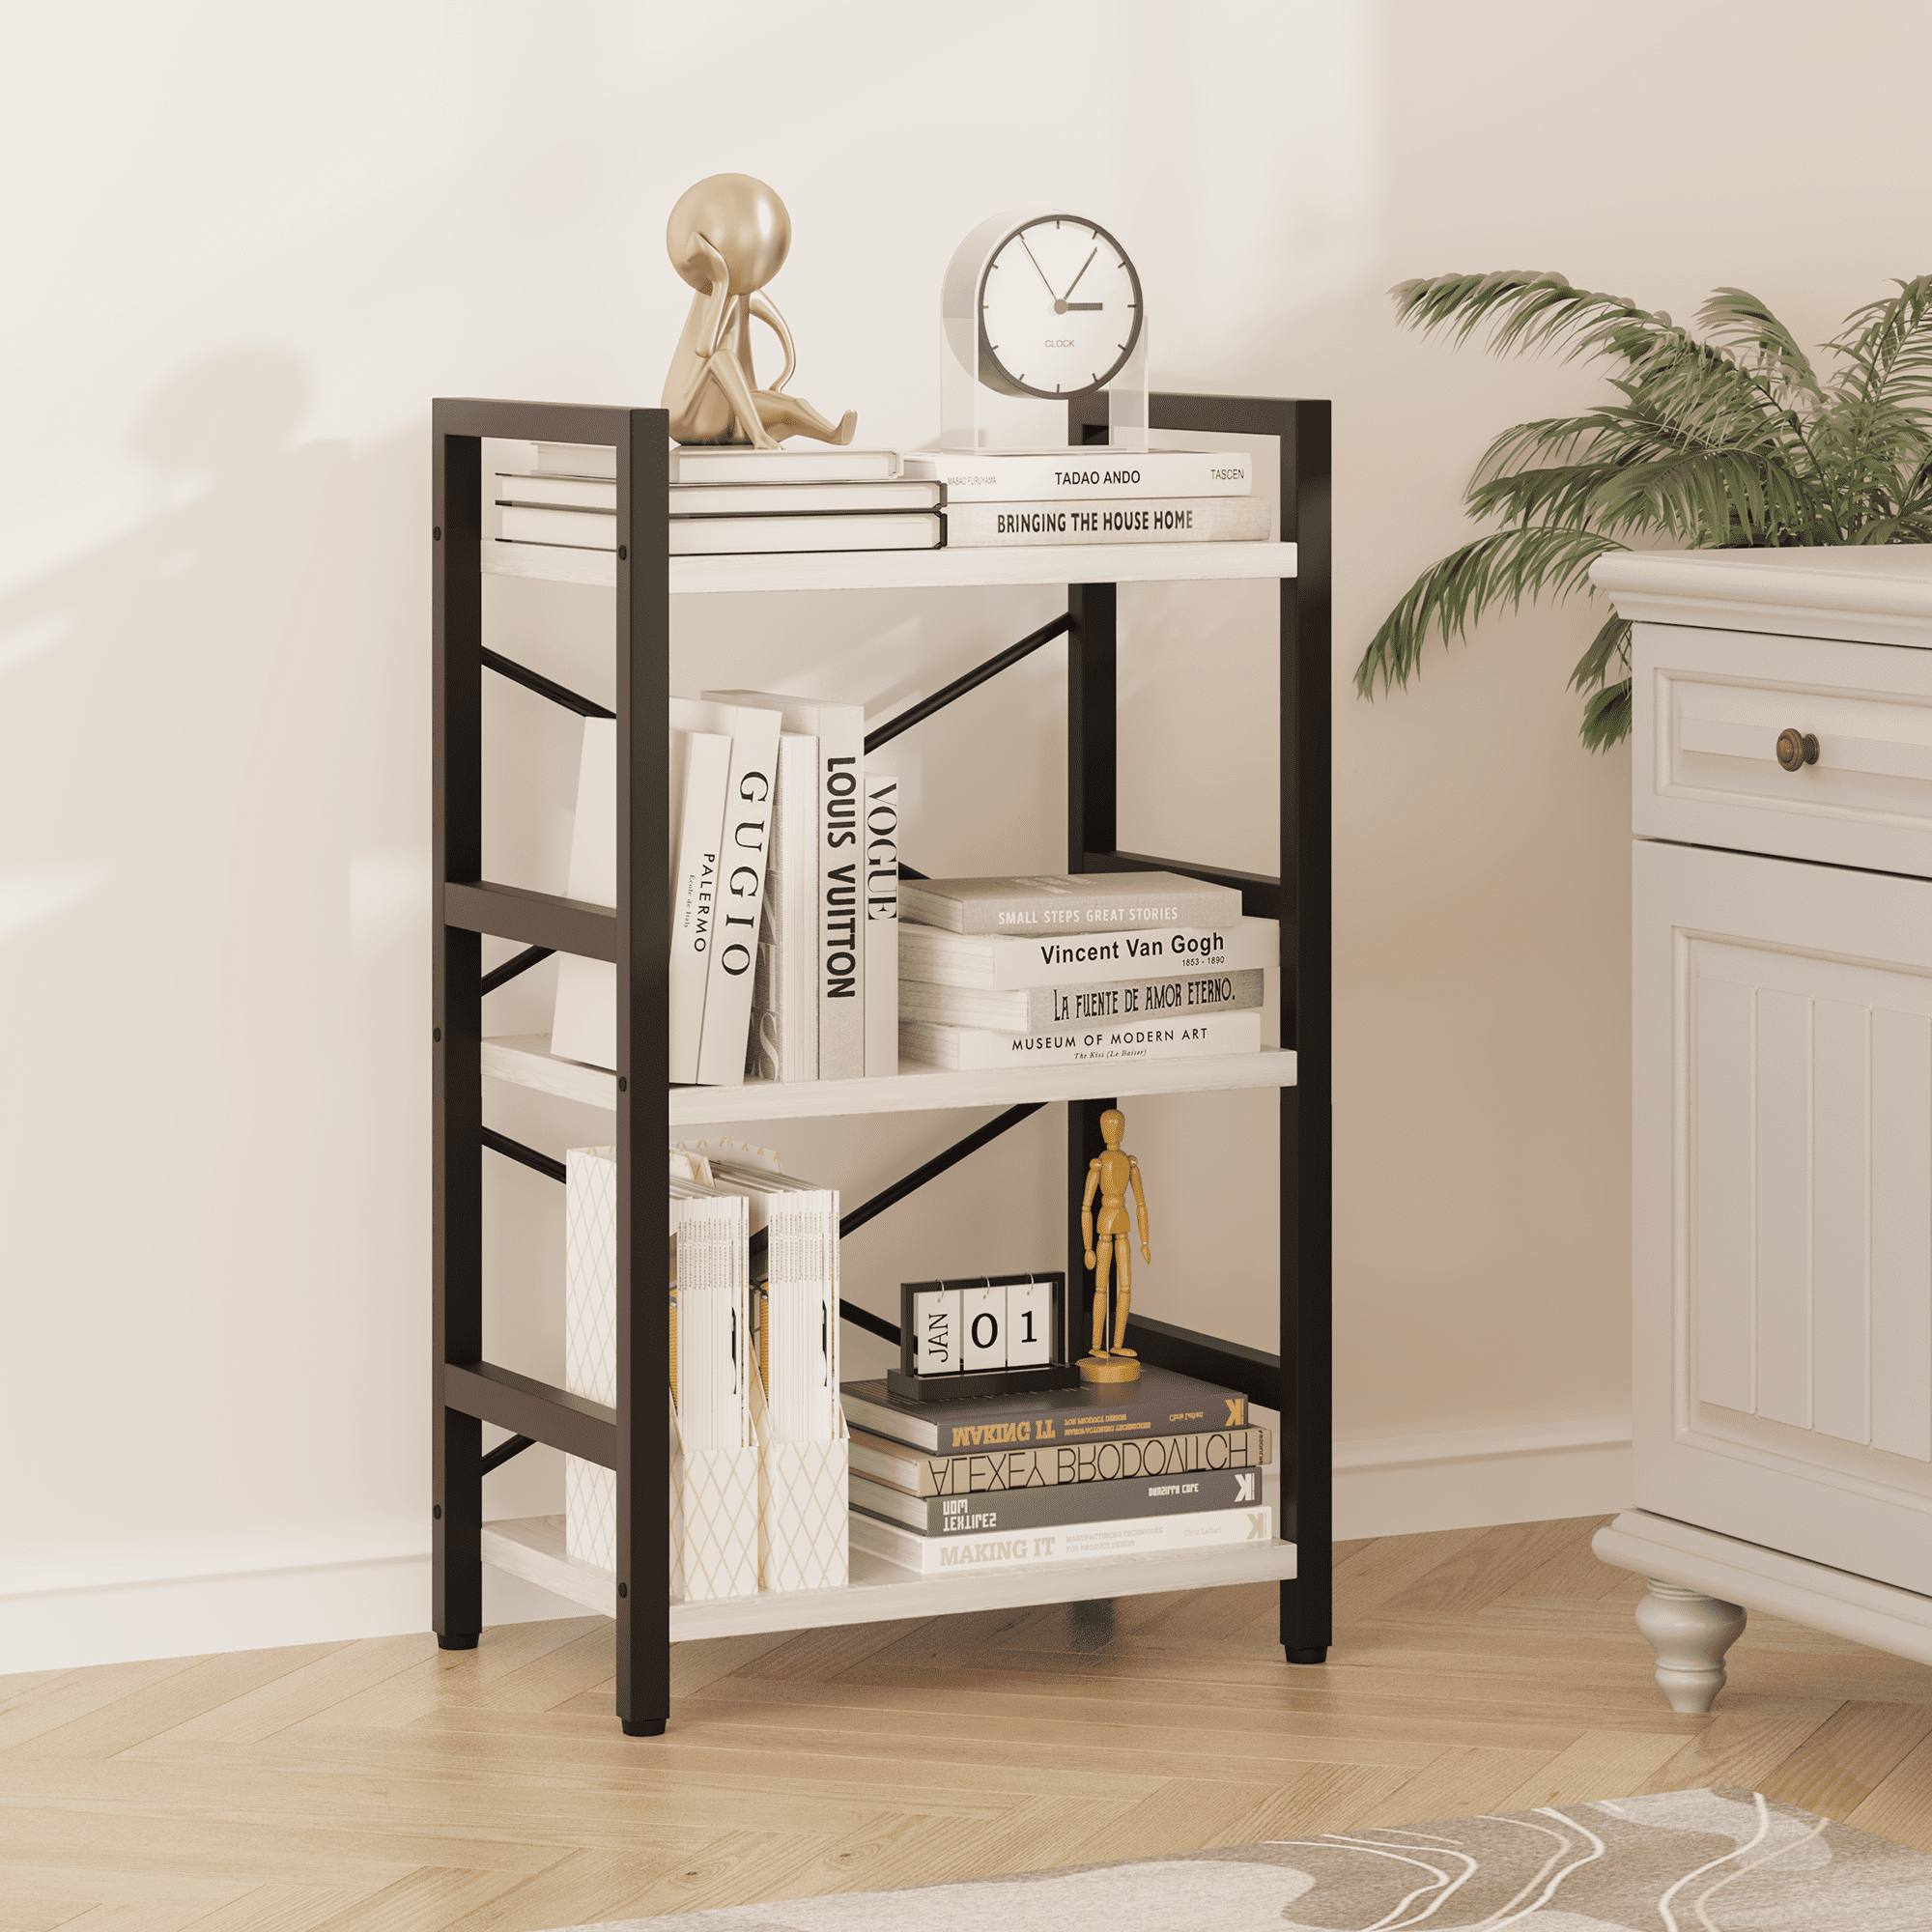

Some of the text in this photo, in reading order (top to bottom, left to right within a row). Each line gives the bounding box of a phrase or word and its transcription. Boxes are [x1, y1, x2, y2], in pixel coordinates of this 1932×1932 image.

[1044, 339, 1075, 348] CLOCK
[1054, 470, 1141, 485] TADAO ANDO
[1210, 469, 1244, 480] TASCEN
[997, 510, 1193, 533] BRINGING THE HOUSE HOME
[867, 782, 898, 921] VOGUE
[721, 771, 769, 976] GUGIO
[826, 756, 857, 998] LOUIS VUITTON
[694, 853, 716, 952] PALERMO
[682, 911, 692, 929] Italy
[998, 907, 1179, 925] SMALL STEPS GREAT STORIES
[1040, 932, 1225, 965] Vincent Van Gogh
[1181, 957, 1199, 967] 1853
[1208, 955, 1225, 965] 1890
[1075, 991, 1119, 1019] FUENTE
[1124, 987, 1140, 1013] DE
[1145, 981, 1182, 1009] AMOR
[1187, 977, 1236, 1006] ETERNO.
[1011, 1027, 1208, 1051] MUSEUM OF MODERN ART
[1090, 1050, 1104, 1059] Kiss
[1106, 1050, 1119, 1059] (Le
[1122, 1048, 1147, 1057] Baiser)
[928, 1314, 949, 1363] JAN
[1065, 1527, 1162, 1543] MANUFACTURING TECHNIQUES
[940, 1538, 1055, 1567] MAKING IT
